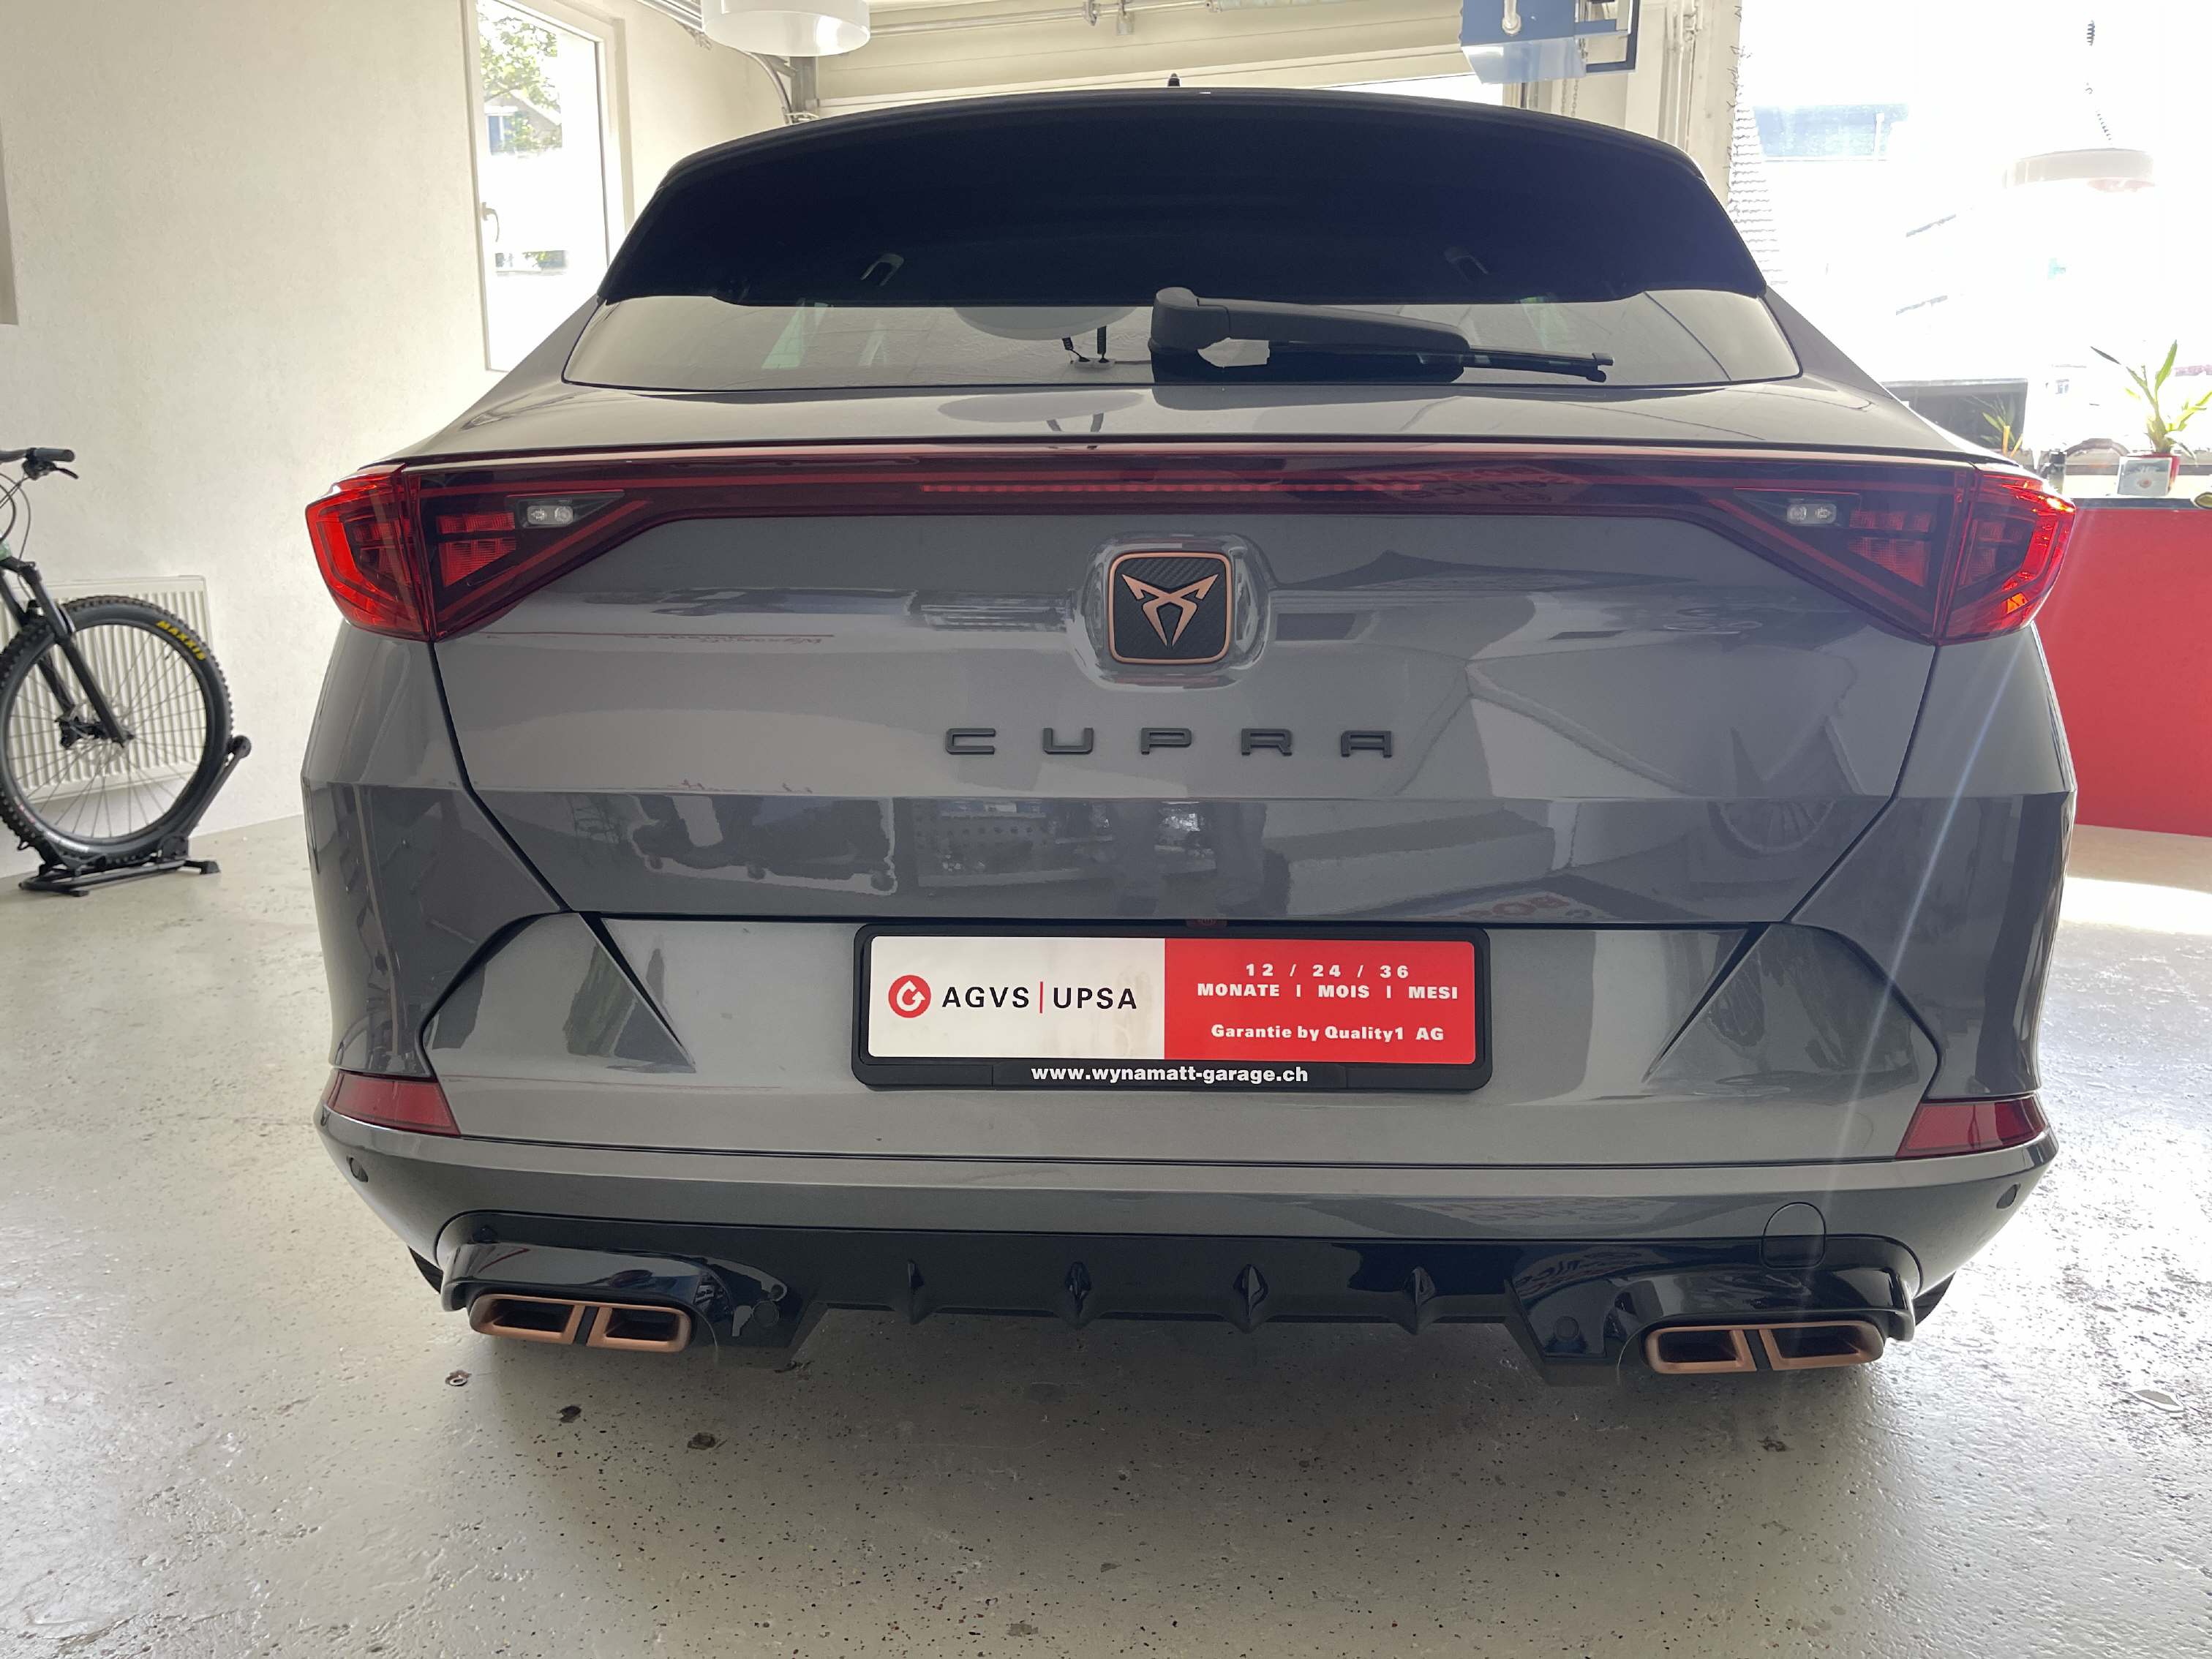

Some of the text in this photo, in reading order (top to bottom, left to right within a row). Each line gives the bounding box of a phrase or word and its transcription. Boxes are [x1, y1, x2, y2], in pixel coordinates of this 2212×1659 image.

[157, 620, 206, 660] MAXXIS
[945, 727, 1393, 758] CUPRA
[1246, 963, 1274, 977] 12
[1312, 964, 1341, 977] 24
[1380, 965, 1409, 979] 36
[941, 986, 1137, 1009] AGVS UPSA
[1197, 983, 1279, 997] MONATE
[1318, 985, 1370, 998] MOIS
[1408, 986, 1458, 999] MESI
[1211, 1024, 1444, 1042] Garantie by Quality1 AG
[1031, 1066, 1308, 1085] www.wynamatt-garage.ch
